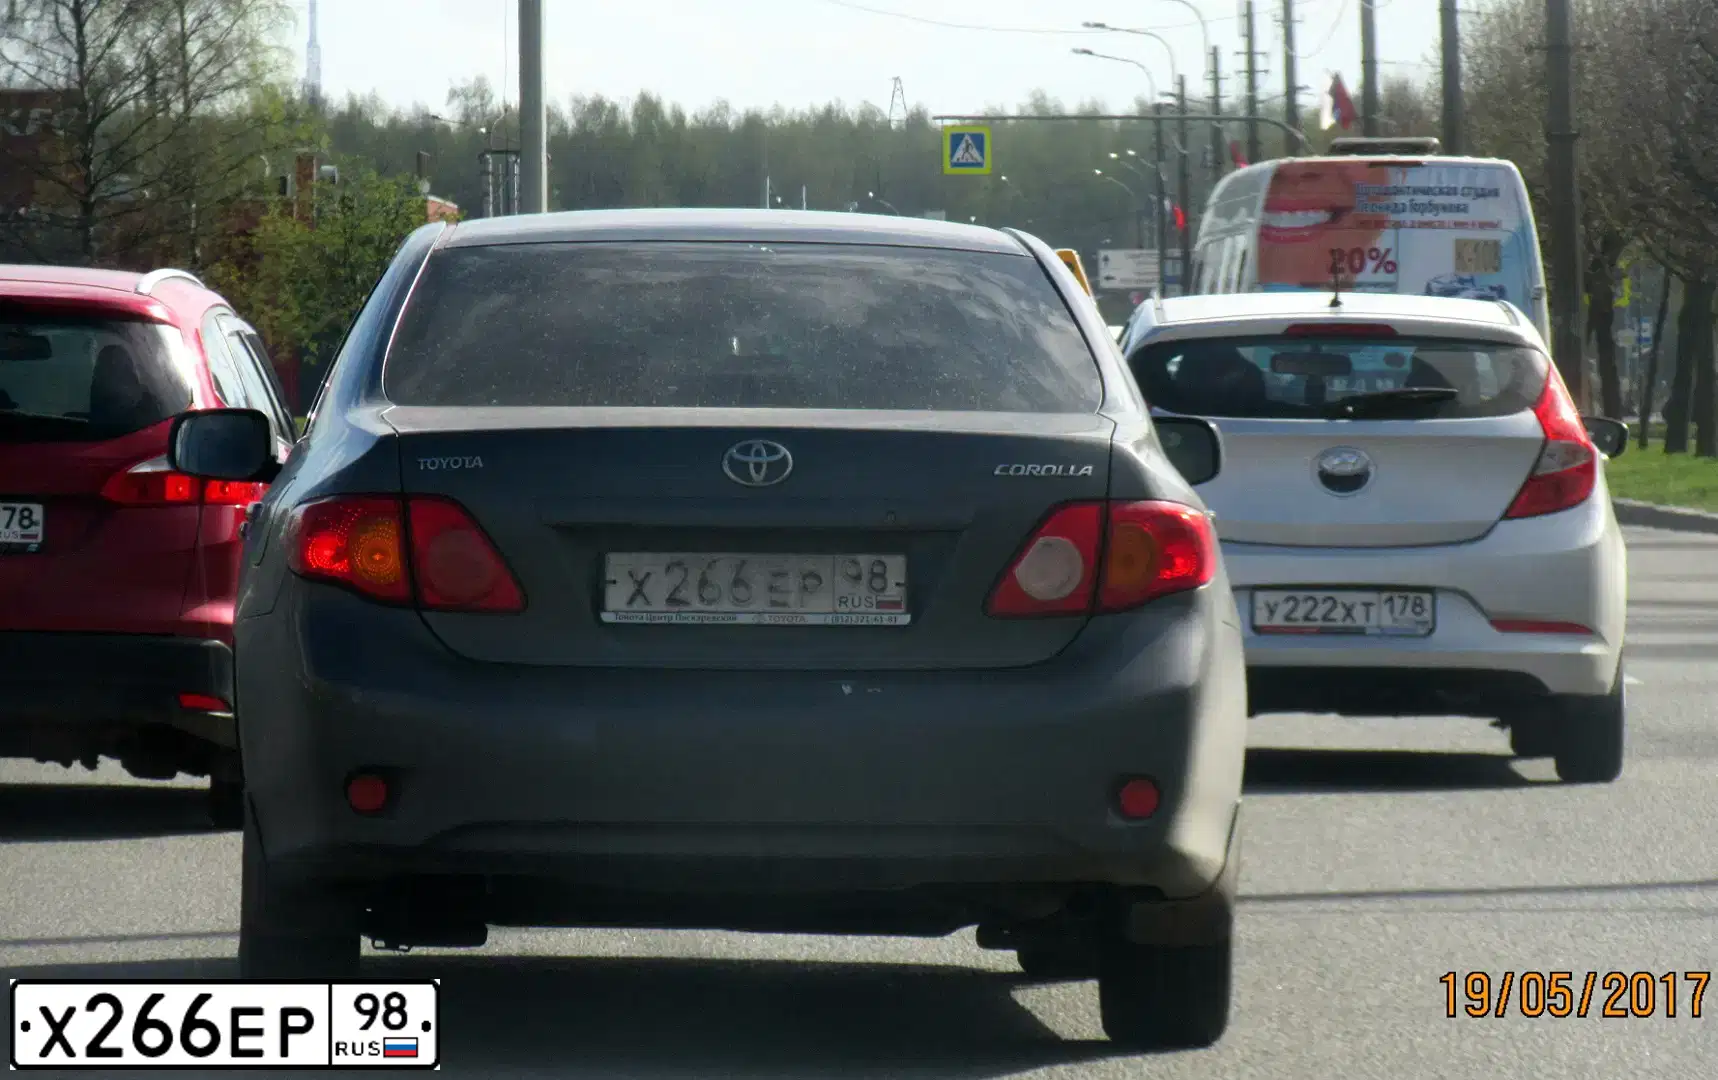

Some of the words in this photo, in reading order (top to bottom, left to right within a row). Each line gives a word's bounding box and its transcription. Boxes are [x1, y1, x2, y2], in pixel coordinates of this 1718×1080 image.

[1328, 247, 1397, 274] 20%
[417, 456, 484, 470] TOYOTA
[994, 463, 1095, 477] COROLLA
[838, 596, 874, 610] RUS
[1383, 595, 1425, 616] 178
[768, 614, 807, 623] TOYOTA
